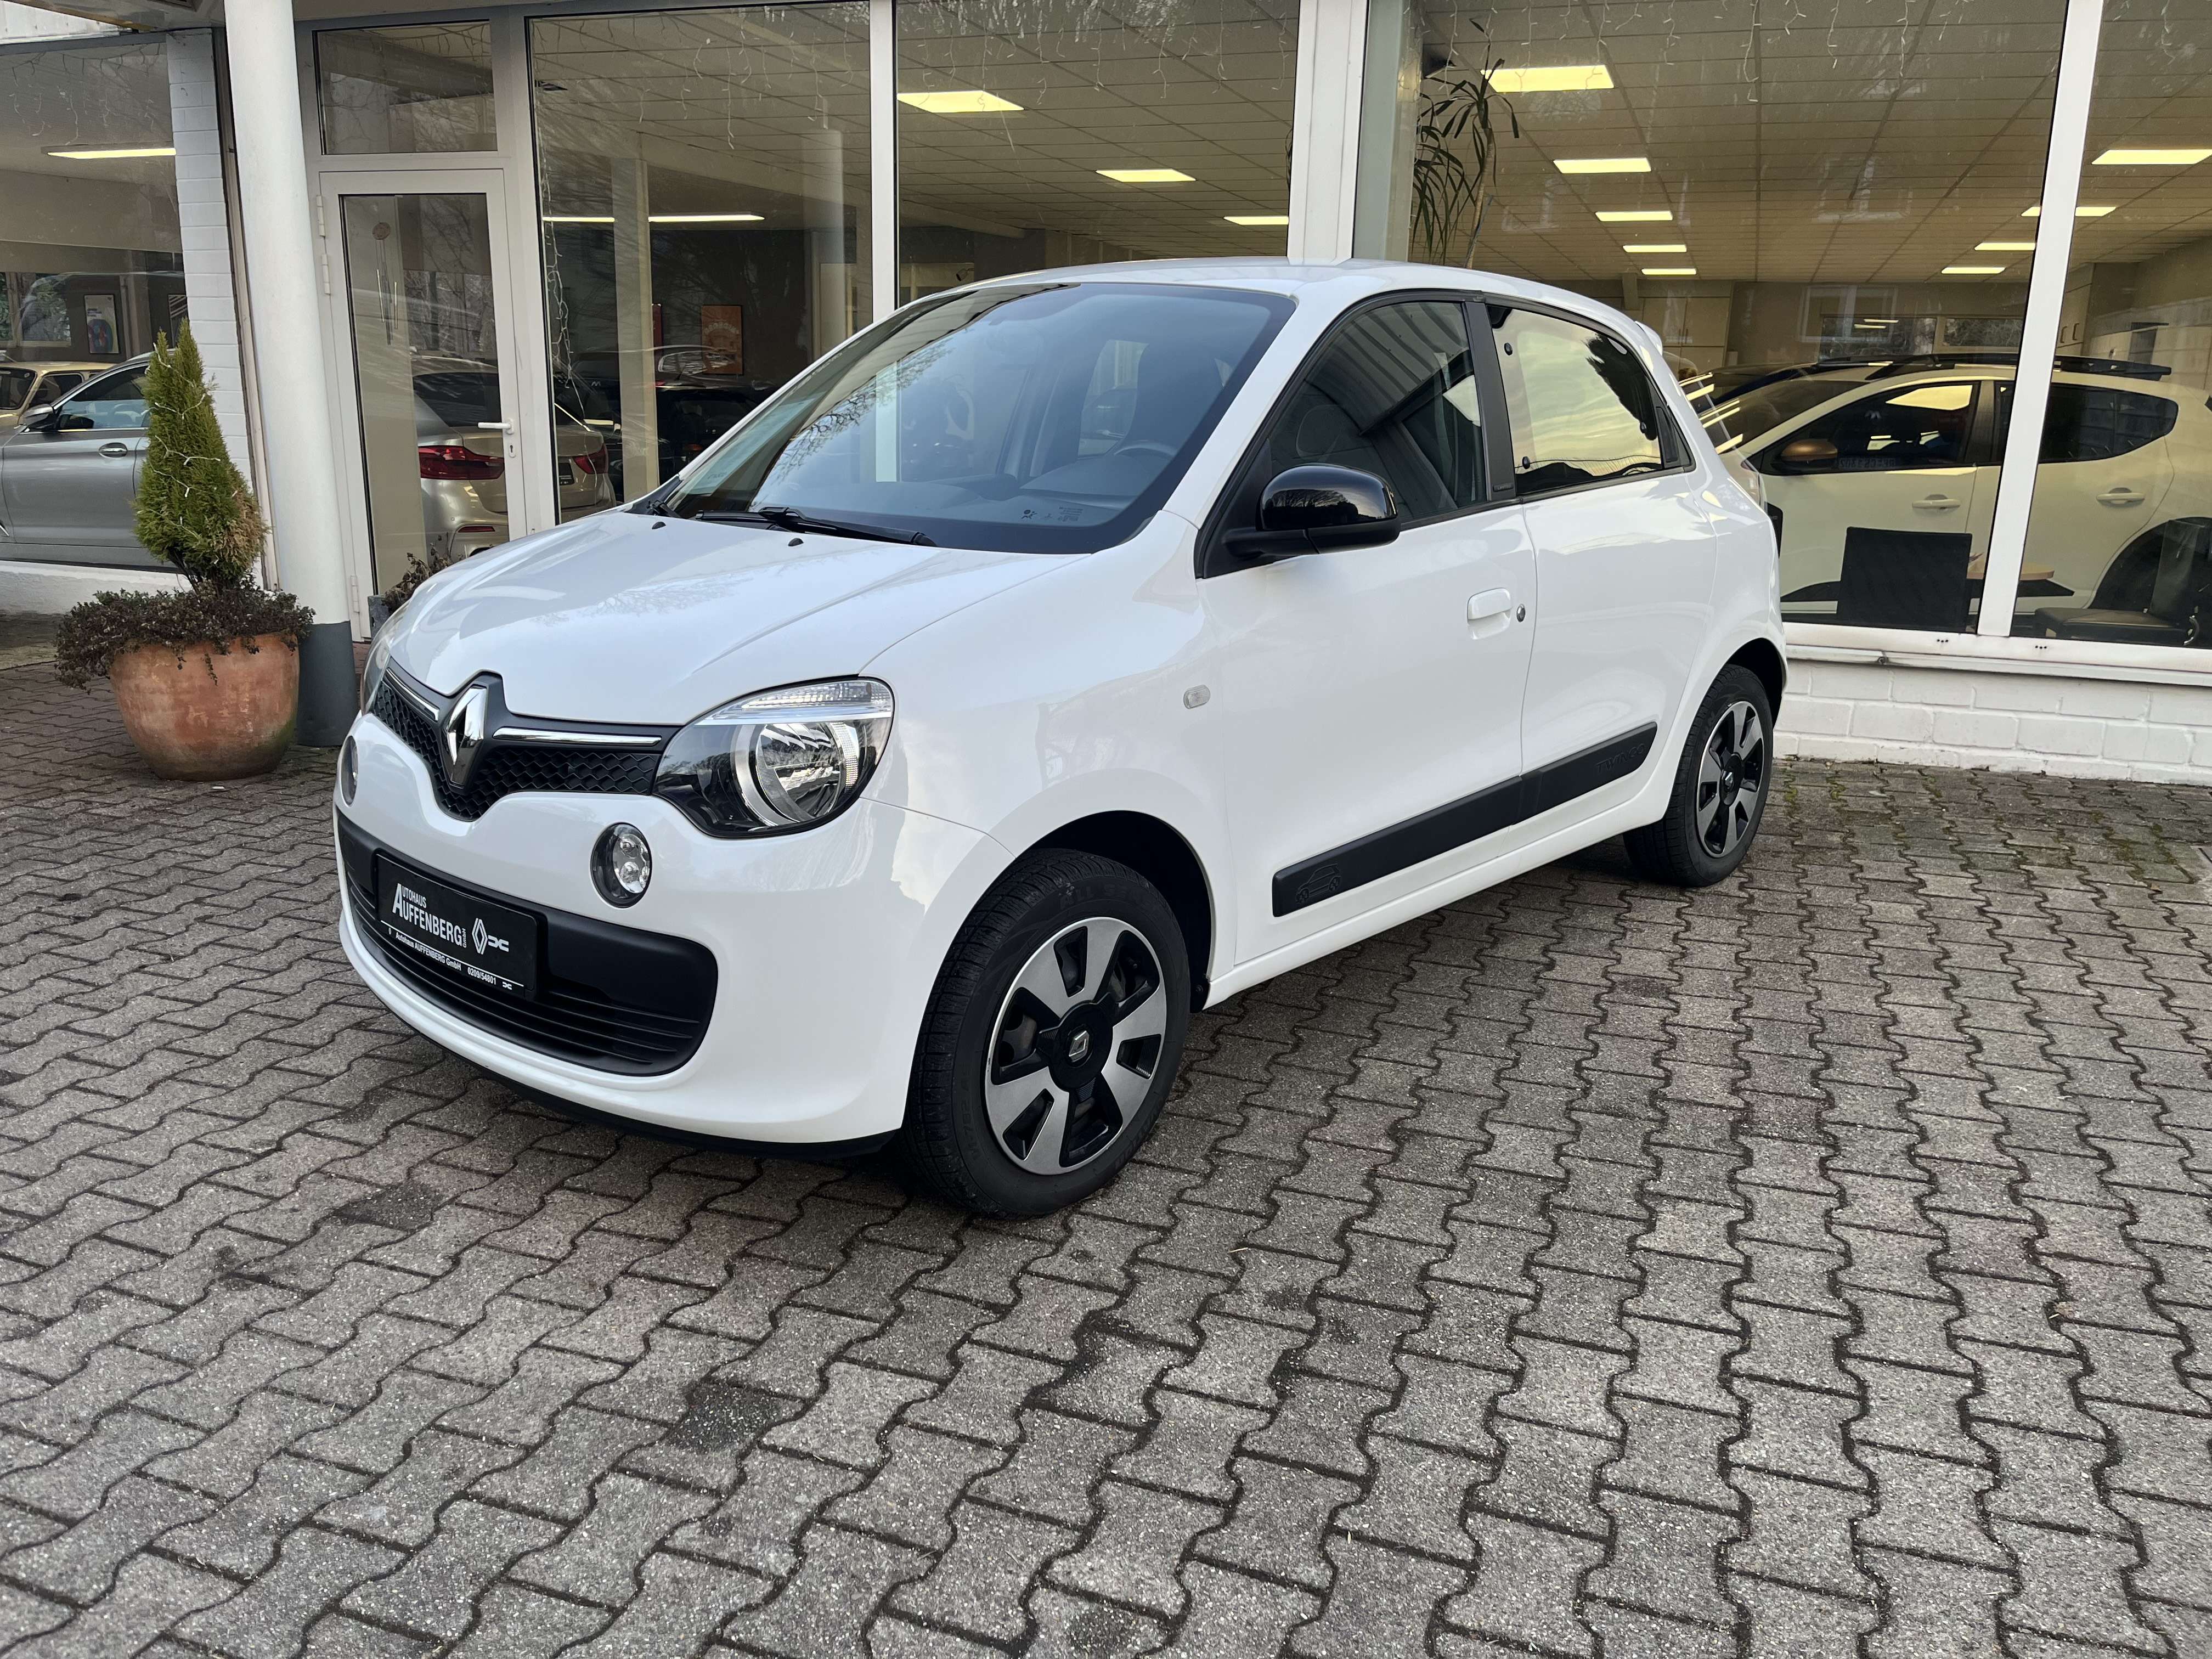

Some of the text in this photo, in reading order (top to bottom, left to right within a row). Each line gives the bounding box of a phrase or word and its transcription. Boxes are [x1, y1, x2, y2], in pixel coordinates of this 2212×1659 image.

[1595, 743, 1645, 773] TWINGO
[392, 883, 463, 947] AUFFENBERG
[395, 932, 496, 985] Autohaus AUFFENBERG GmbH 0209/54801
